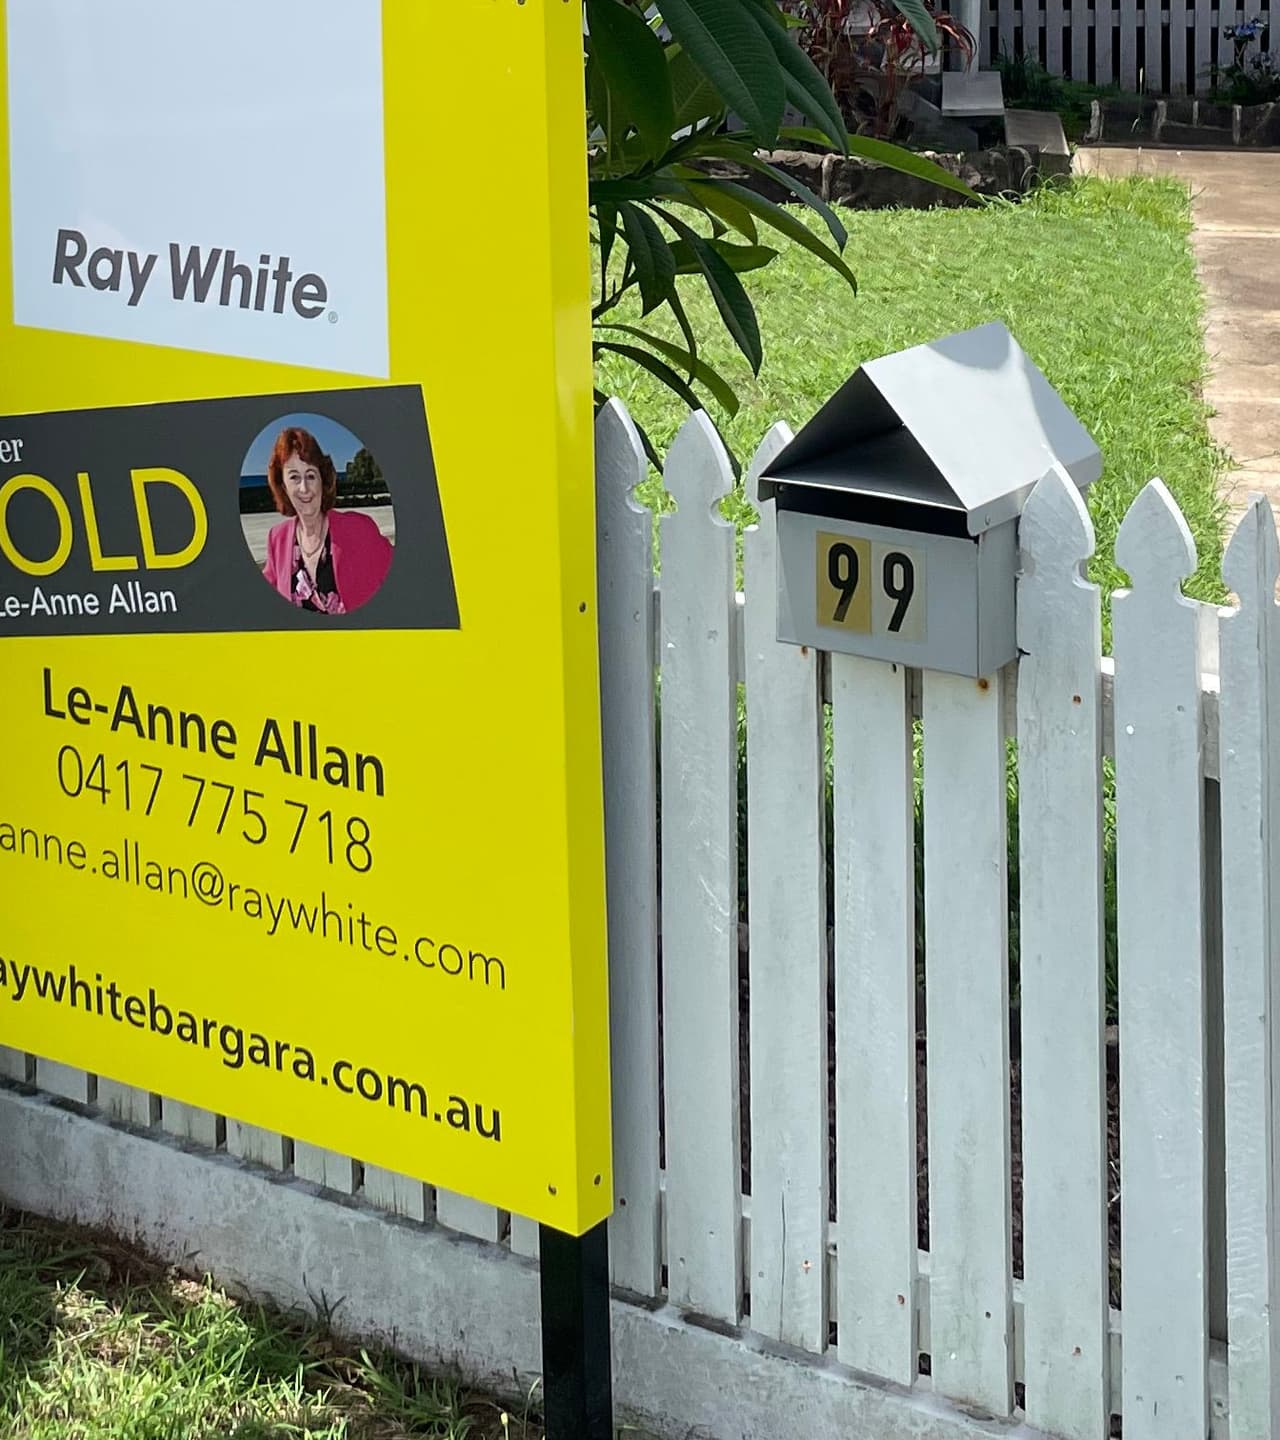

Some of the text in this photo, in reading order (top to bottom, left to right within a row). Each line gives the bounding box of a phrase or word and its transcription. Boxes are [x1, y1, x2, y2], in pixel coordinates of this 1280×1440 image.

[52, 228, 328, 320] Ray White
[109, 580, 177, 616] Allan
[828, 542, 914, 632] 99
[43, 667, 384, 795] Le-Anne Allan
[58, 745, 371, 873] 0417 775 718
